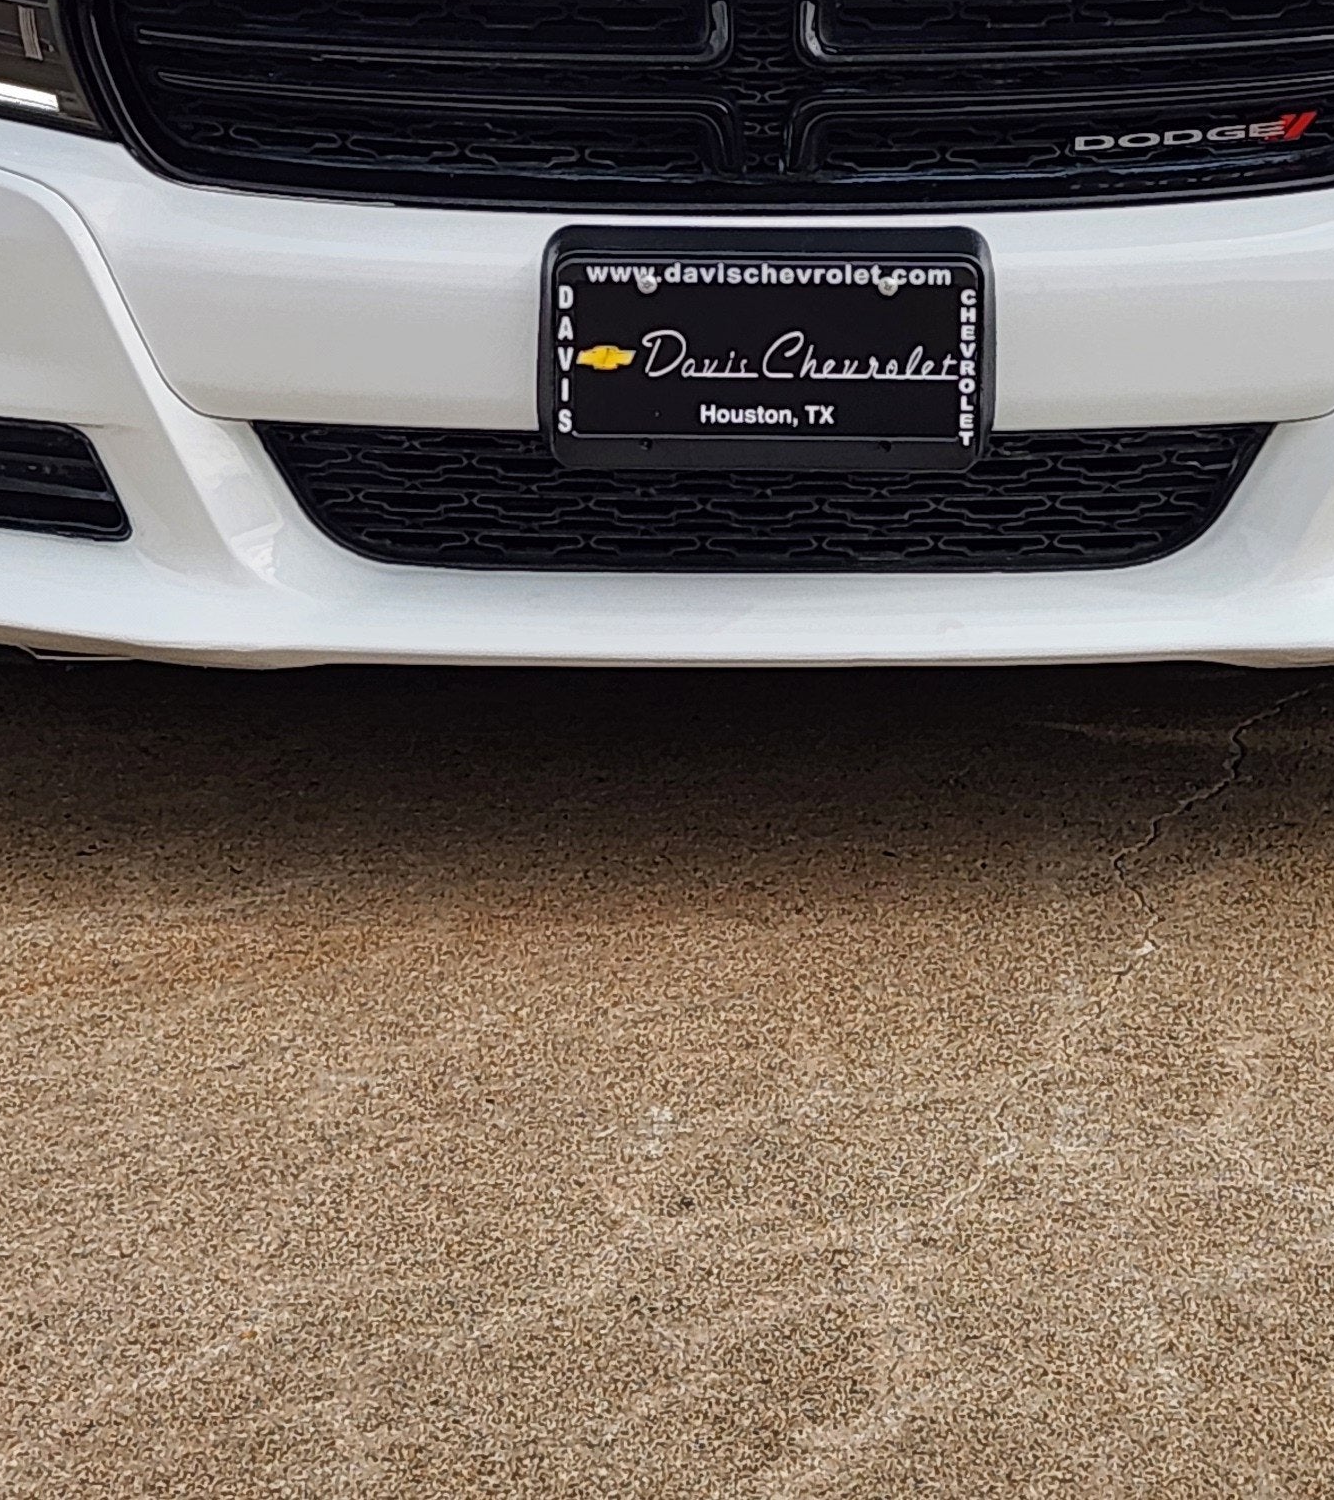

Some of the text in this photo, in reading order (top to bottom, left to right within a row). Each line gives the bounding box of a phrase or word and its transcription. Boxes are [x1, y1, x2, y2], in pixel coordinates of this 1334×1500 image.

[1074, 120, 1286, 151] DODGE
[586, 261, 952, 286] www.davischevroletcom
[557, 285, 574, 434] DAVIS
[641, 329, 959, 380] Davis Chevrolet
[959, 288, 976, 446] CHEVROLET
[700, 404, 834, 427] Houston, TX
